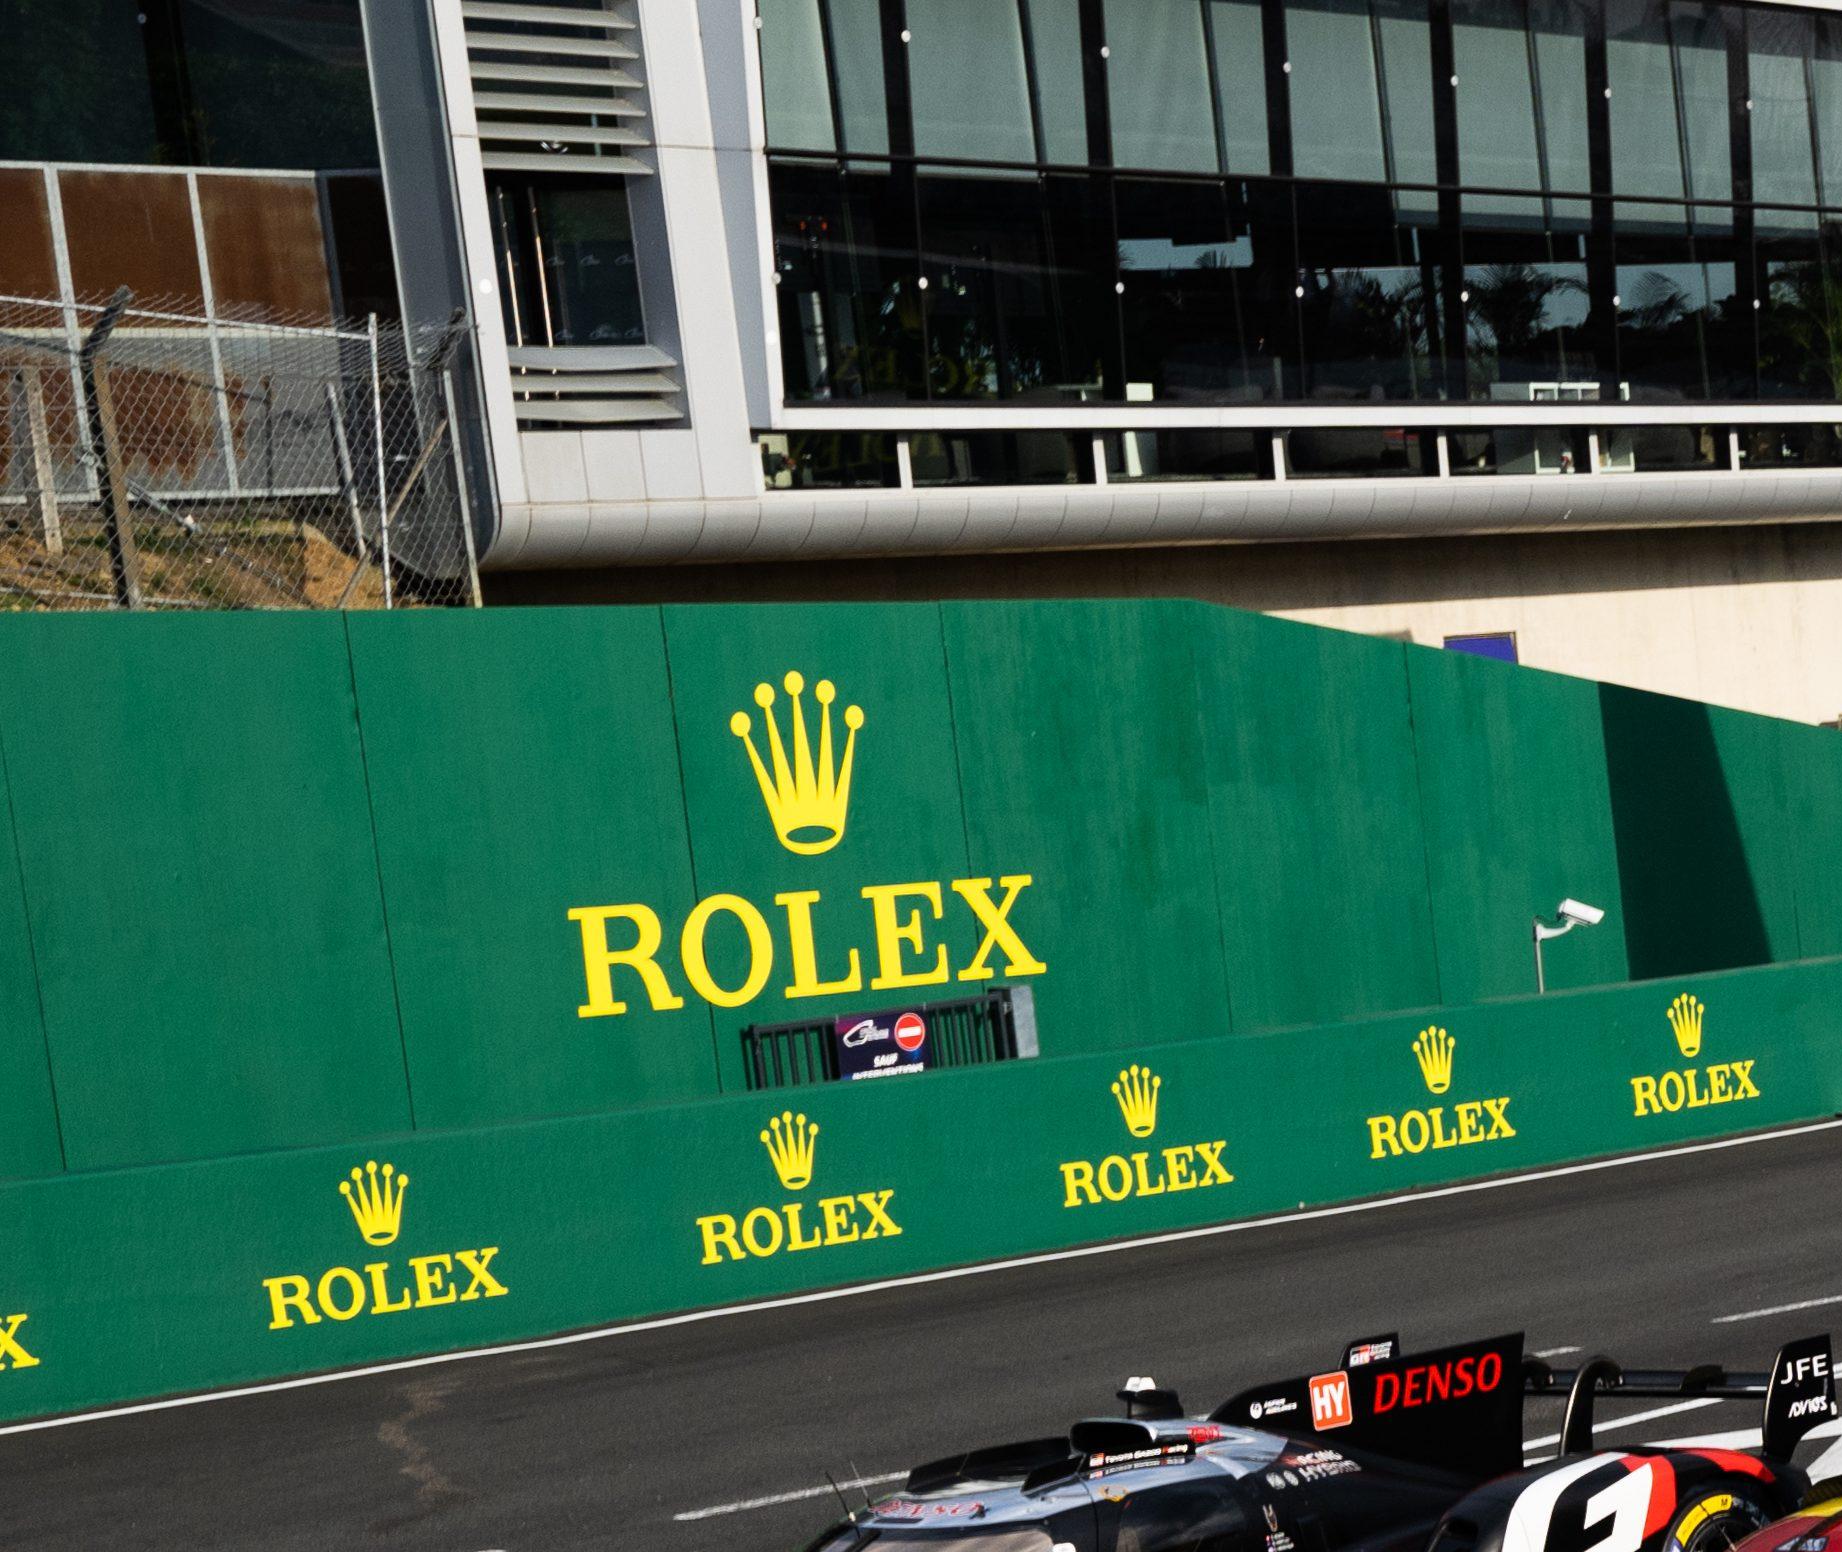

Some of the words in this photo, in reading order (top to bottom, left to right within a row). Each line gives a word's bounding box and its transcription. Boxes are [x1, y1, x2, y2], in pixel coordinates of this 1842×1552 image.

[567, 873, 1047, 1019] ROLEX
[1631, 1059, 1761, 1118] ROLEX
[1369, 1097, 1517, 1160] ROLEX
[1061, 1139, 1234, 1208] ROLEX
[696, 1189, 903, 1266] ROLEX
[262, 1247, 508, 1331] ROLEX
[1312, 1381, 1347, 1421] HY
[1373, 1351, 1502, 1414] DENSO
[1779, 1353, 1830, 1386] JFE
